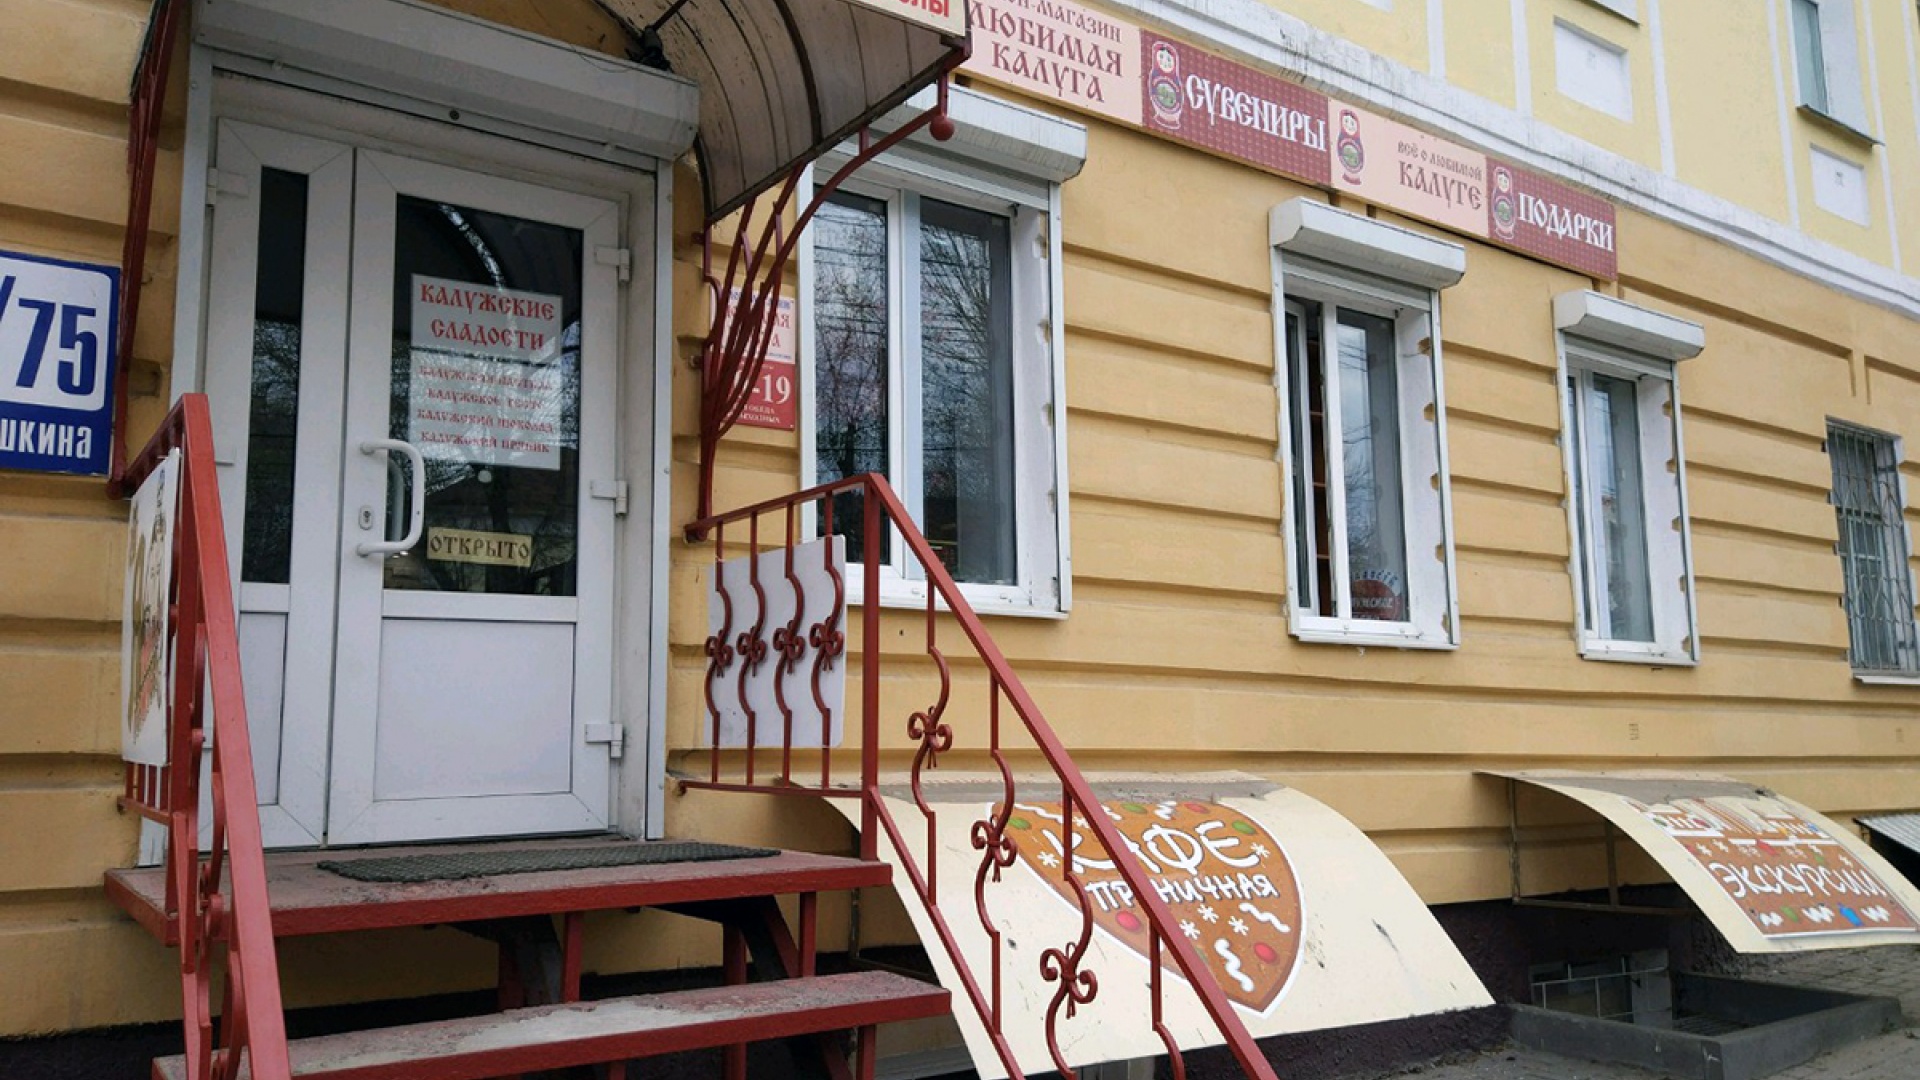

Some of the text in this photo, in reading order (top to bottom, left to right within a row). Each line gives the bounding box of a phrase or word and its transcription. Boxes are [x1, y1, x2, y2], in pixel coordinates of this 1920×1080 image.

[970, 1, 1122, 77] ЛЮБИМАЯ
[1006, 0, 1122, 43] Н-МАГАЗИН
[991, 41, 1104, 103] КАЛУГА
[1186, 73, 1326, 151] СУВЕНИРЫ
[1399, 160, 1482, 210] КАЛУГЕ
[1518, 192, 1614, 251] ПОДАРКИ
[420, 284, 555, 320] КАЛУЖСКИЕ
[431, 318, 544, 350] СЛАДОСТИ
[430, 534, 530, 560] ОТКРЫТО
[1084, 873, 1280, 912] ПРНИЧНАЯ
[1709, 862, 1888, 898] ЭКСКУРСИИ
